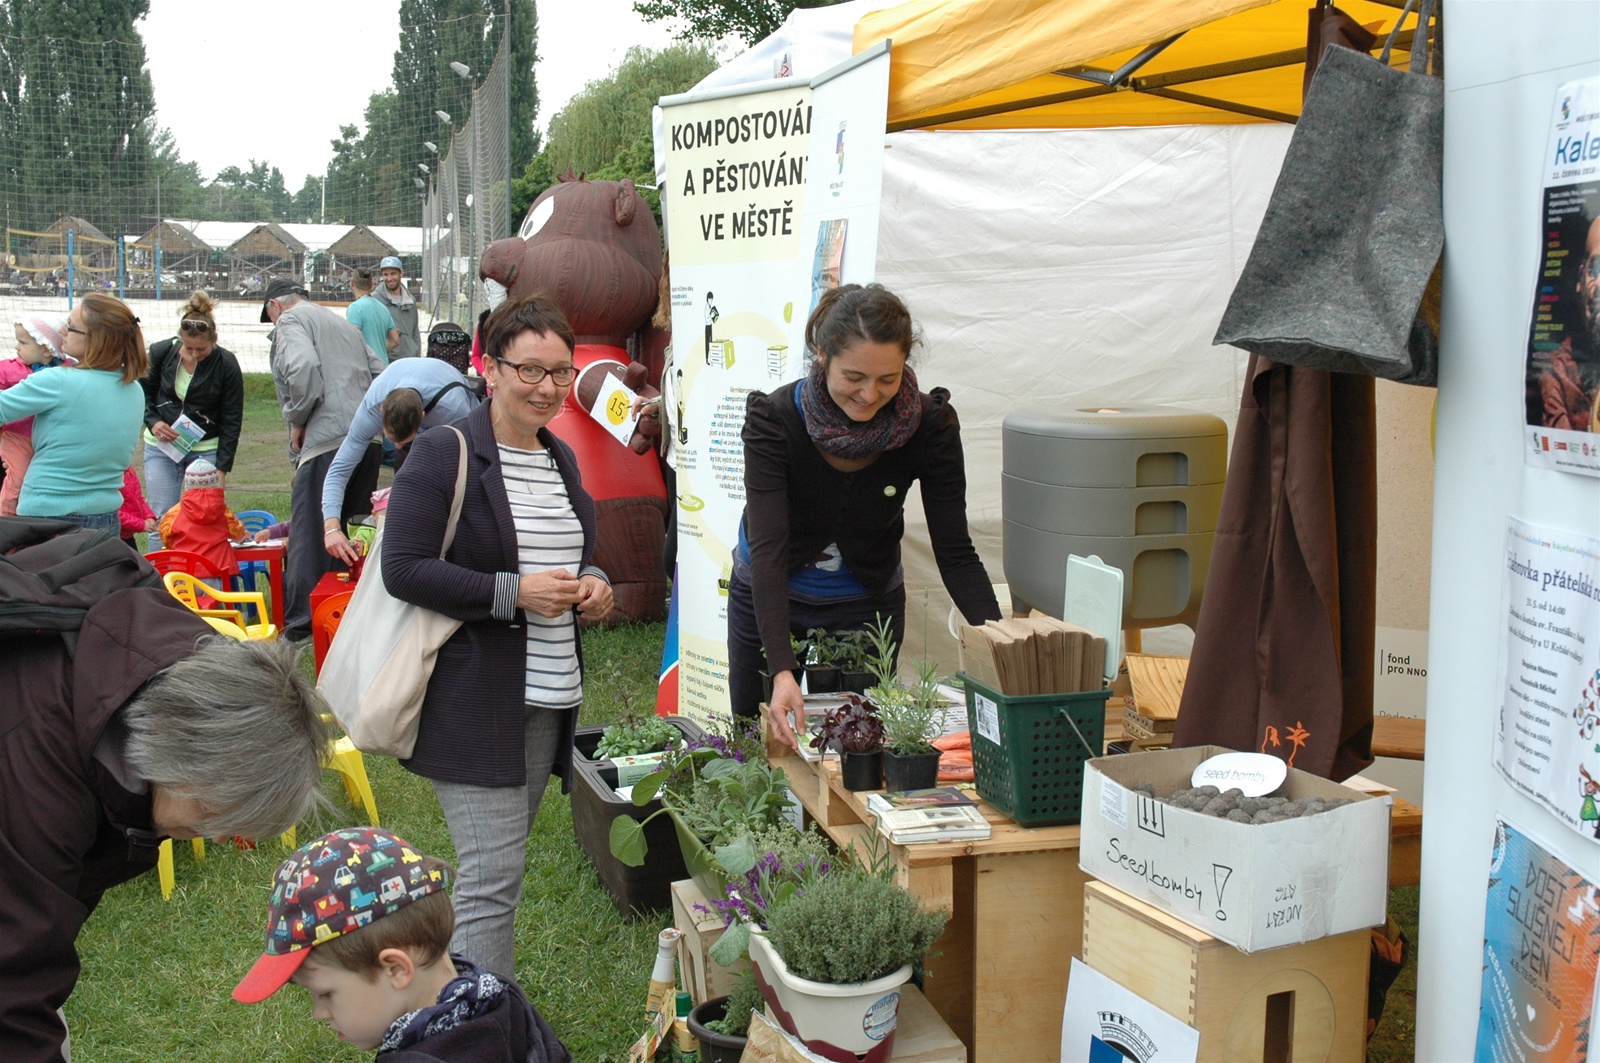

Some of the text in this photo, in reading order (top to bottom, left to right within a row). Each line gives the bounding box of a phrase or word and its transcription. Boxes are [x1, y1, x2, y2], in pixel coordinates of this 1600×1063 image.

[683, 169, 696, 196] A
[700, 199, 793, 241] VE MĚSTĚ
[609, 397, 625, 420] 15.
[1387, 652, 1410, 665] fond
[1387, 665, 1428, 677] pro NNO
[1203, 767, 1268, 785] seed bomby
[1525, 860, 1567, 913] DOST
[1506, 884, 1576, 964] SLUŠNEJ
[1520, 931, 1550, 983] DEN
